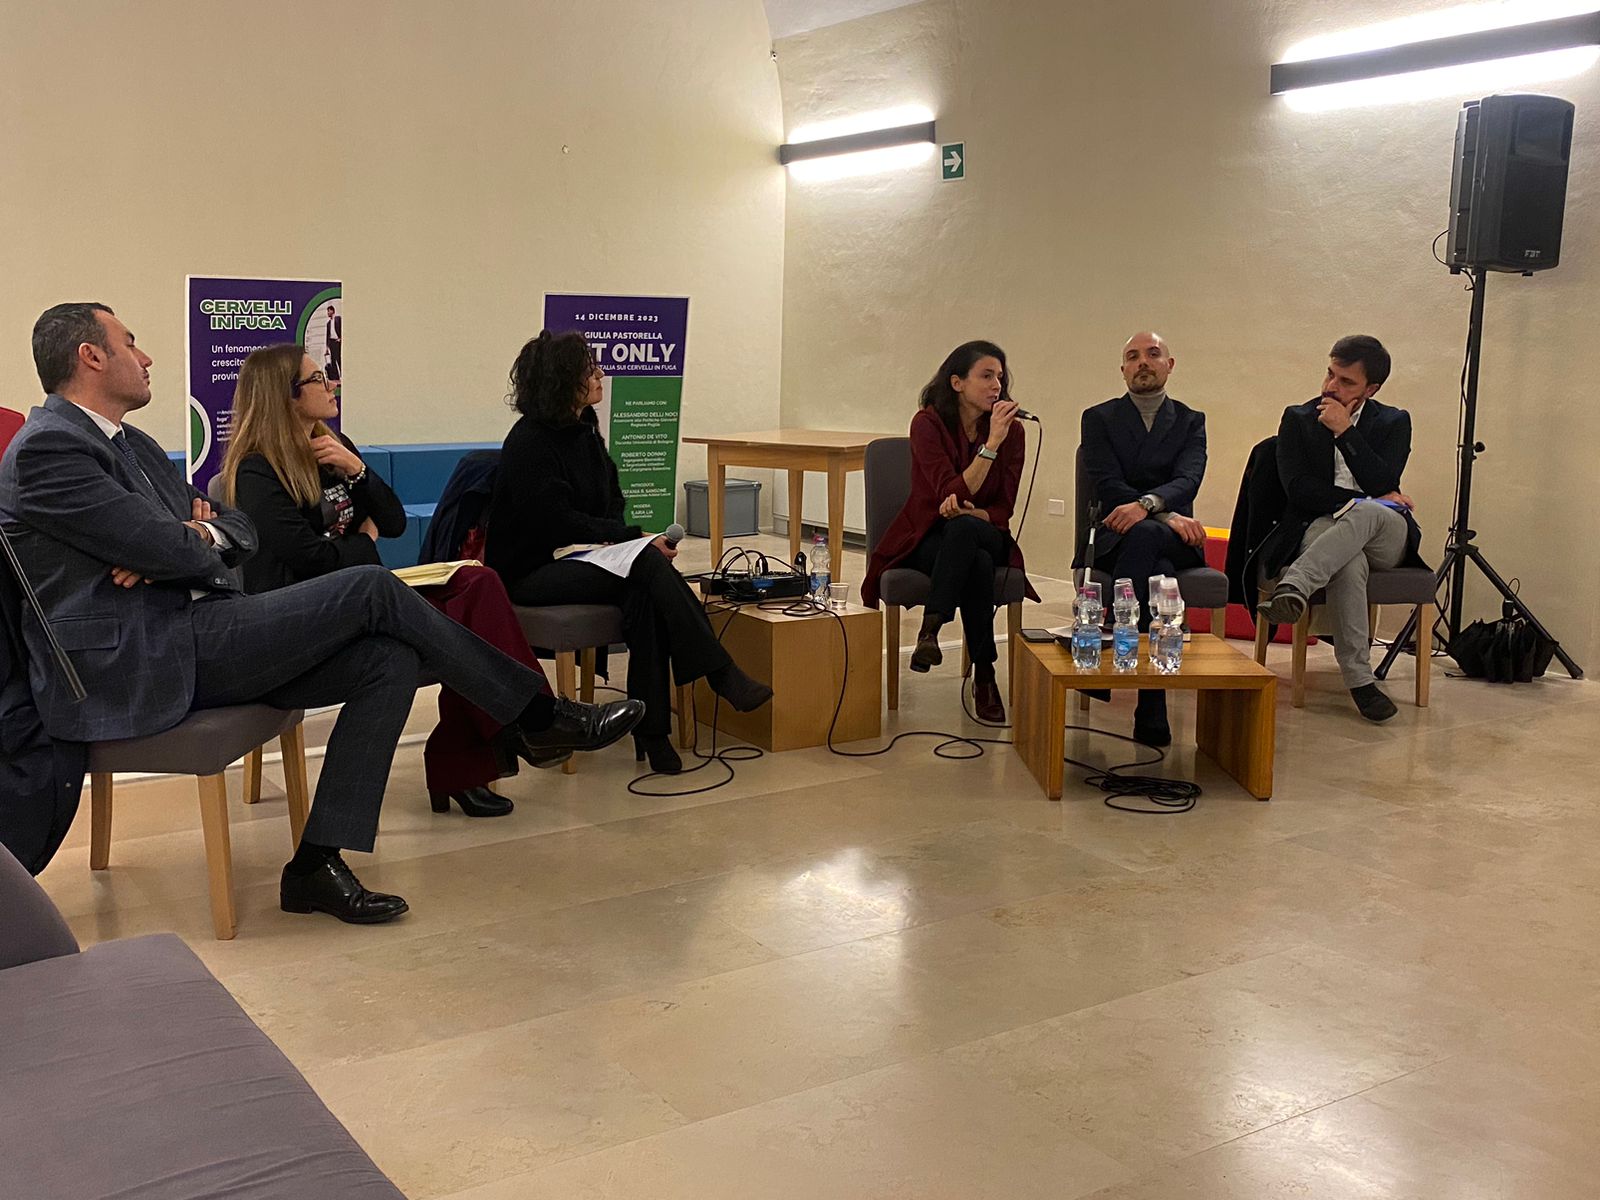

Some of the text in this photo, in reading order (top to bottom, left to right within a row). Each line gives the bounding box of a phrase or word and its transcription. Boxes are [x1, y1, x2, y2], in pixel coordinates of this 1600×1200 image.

[200, 299, 292, 315] CERVELLI
[210, 315, 287, 330] IN FUGA
[588, 313, 635, 321] DICEMBRE
[637, 315, 659, 323] 2023
[584, 331, 663, 340] GIULIA PASTORELLA
[211, 345, 224, 354] Un
[611, 343, 676, 363] ONLY
